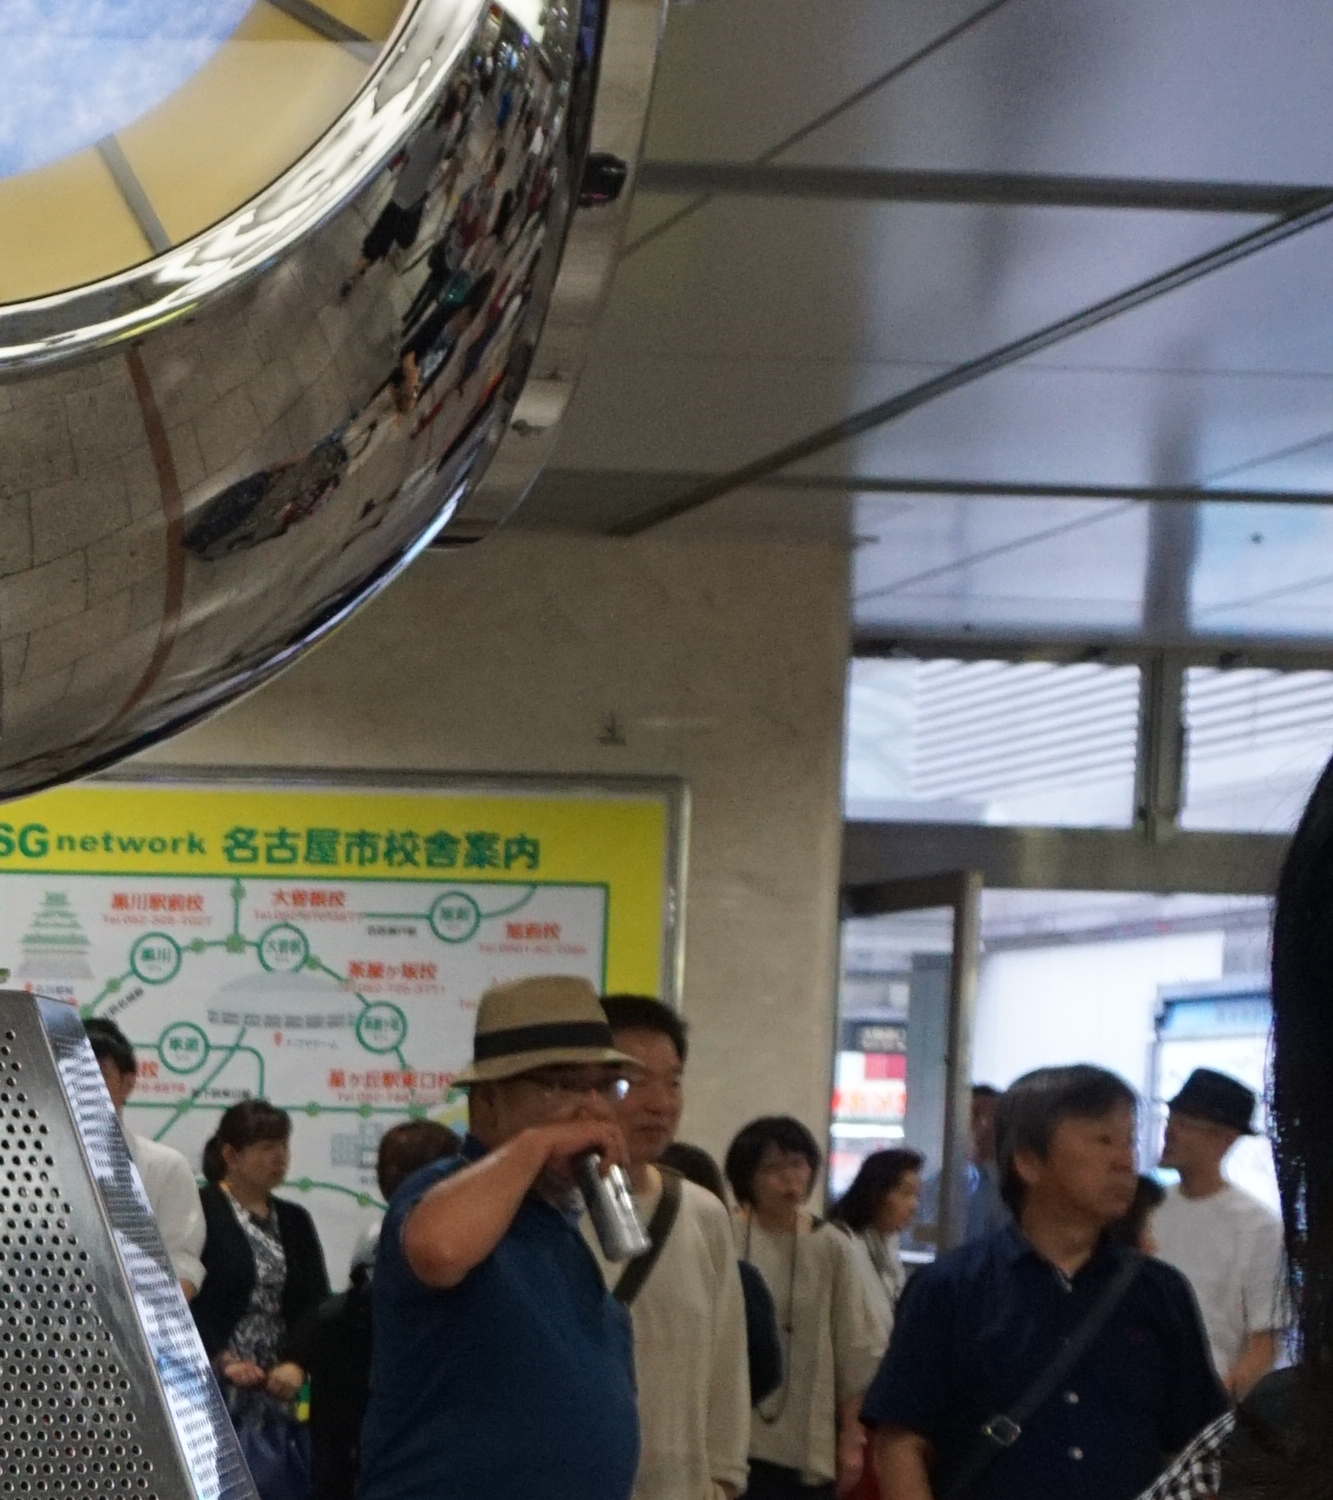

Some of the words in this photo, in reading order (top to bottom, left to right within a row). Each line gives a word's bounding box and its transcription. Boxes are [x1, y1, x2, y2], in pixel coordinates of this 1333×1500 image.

[57, 832, 207, 856] network
[223, 826, 540, 870] 名古屋市校舎案内
